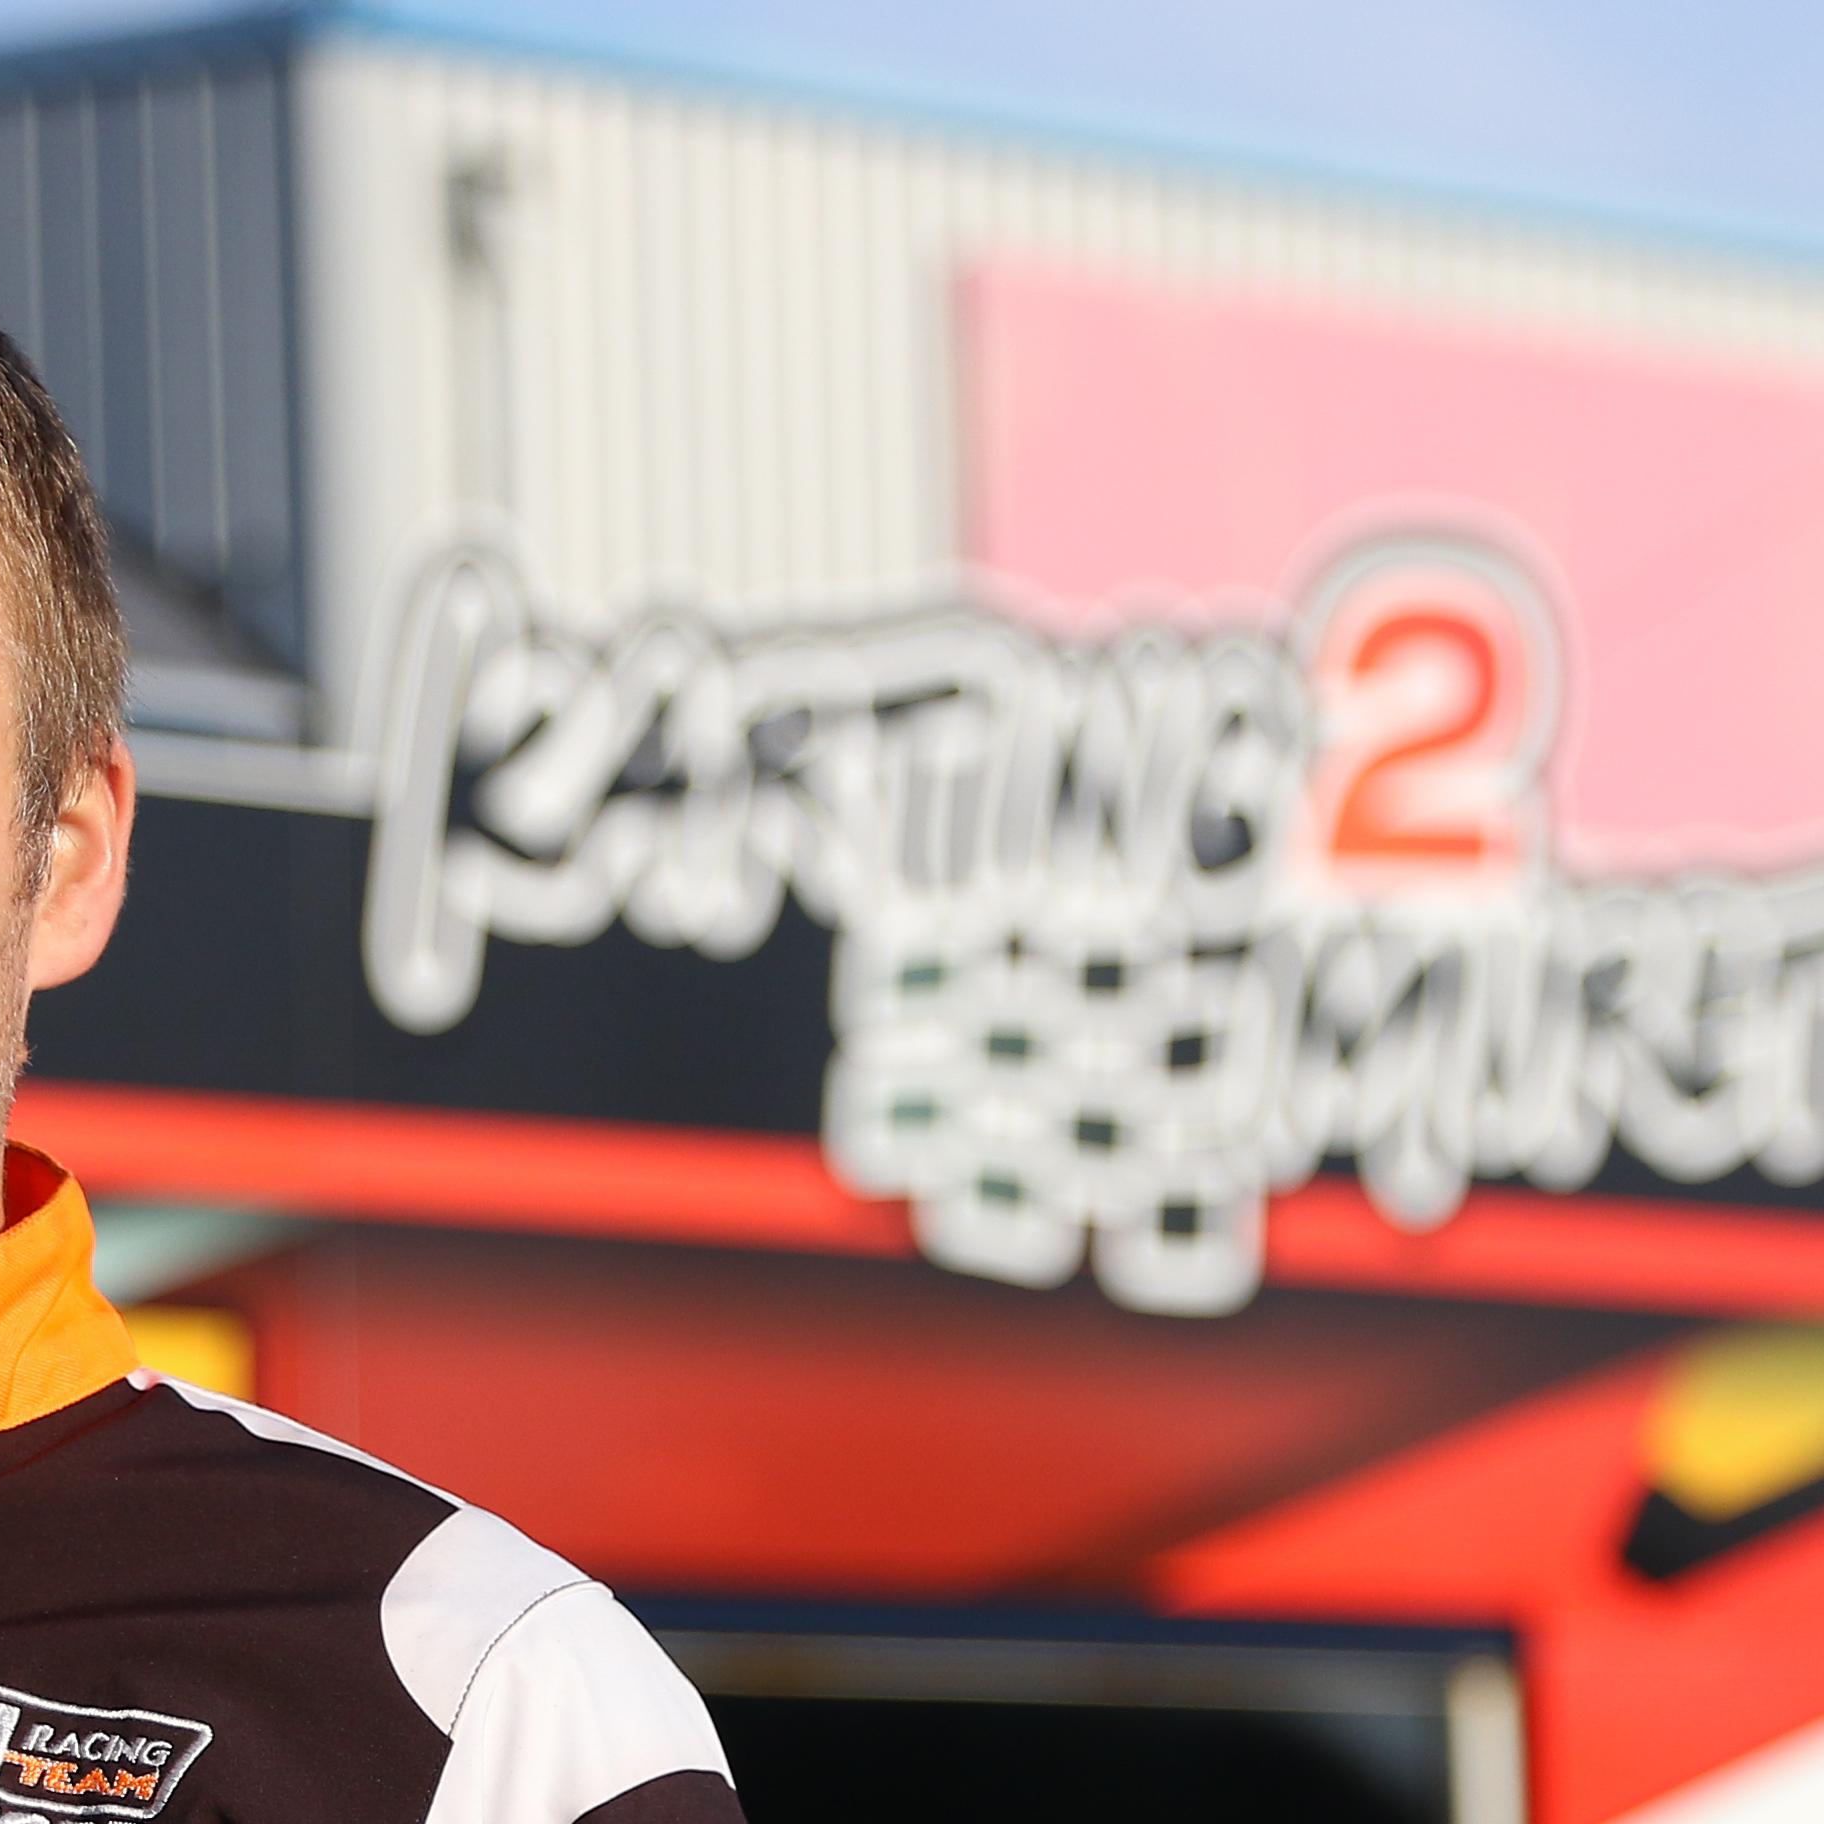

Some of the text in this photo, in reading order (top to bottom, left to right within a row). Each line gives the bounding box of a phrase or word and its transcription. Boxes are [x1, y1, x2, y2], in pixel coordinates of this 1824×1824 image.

[361, 550, 1501, 1035] KARTING 2
[22, 1723, 172, 1767] RACING
[3, 1750, 159, 1801] TEAM
